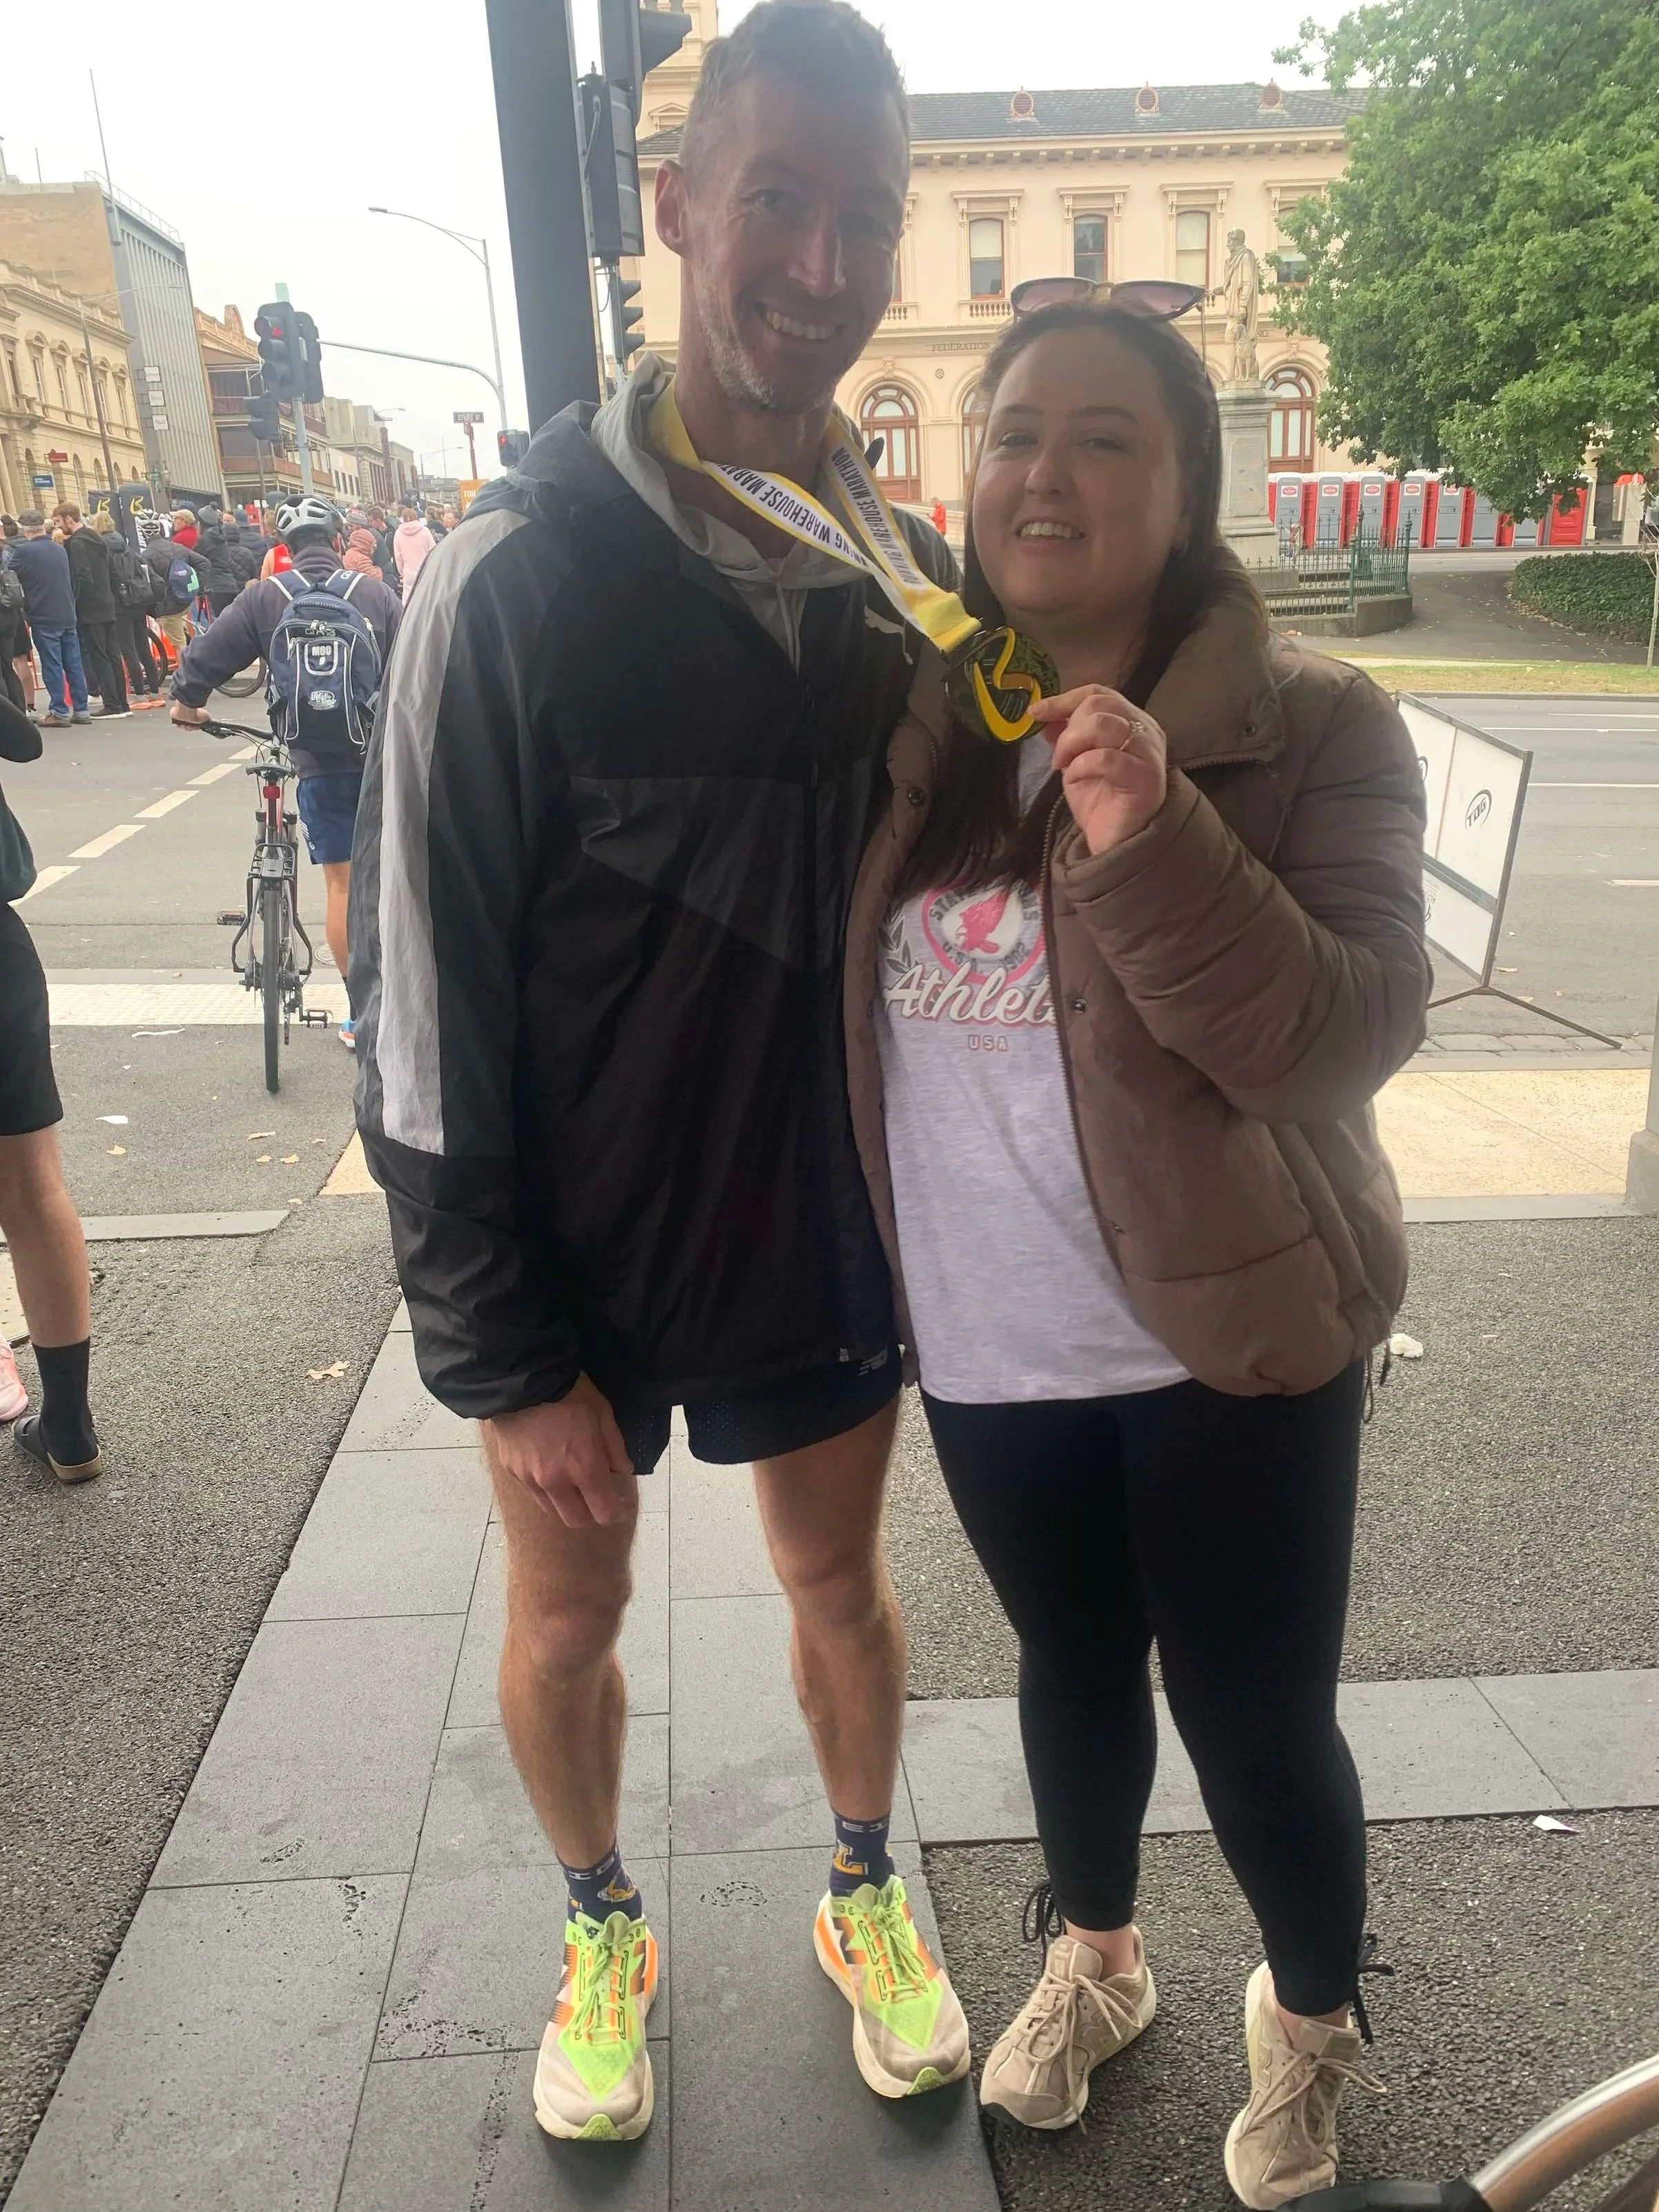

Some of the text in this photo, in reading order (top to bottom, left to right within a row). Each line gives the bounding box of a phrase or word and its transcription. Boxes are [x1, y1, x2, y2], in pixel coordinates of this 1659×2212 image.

[831, 447, 872, 500] MARATHON
[759, 485, 831, 543] WAREHOUSE
[857, 498, 898, 552] WAREHOUSE
[967, 1035, 1009, 1051] USA
